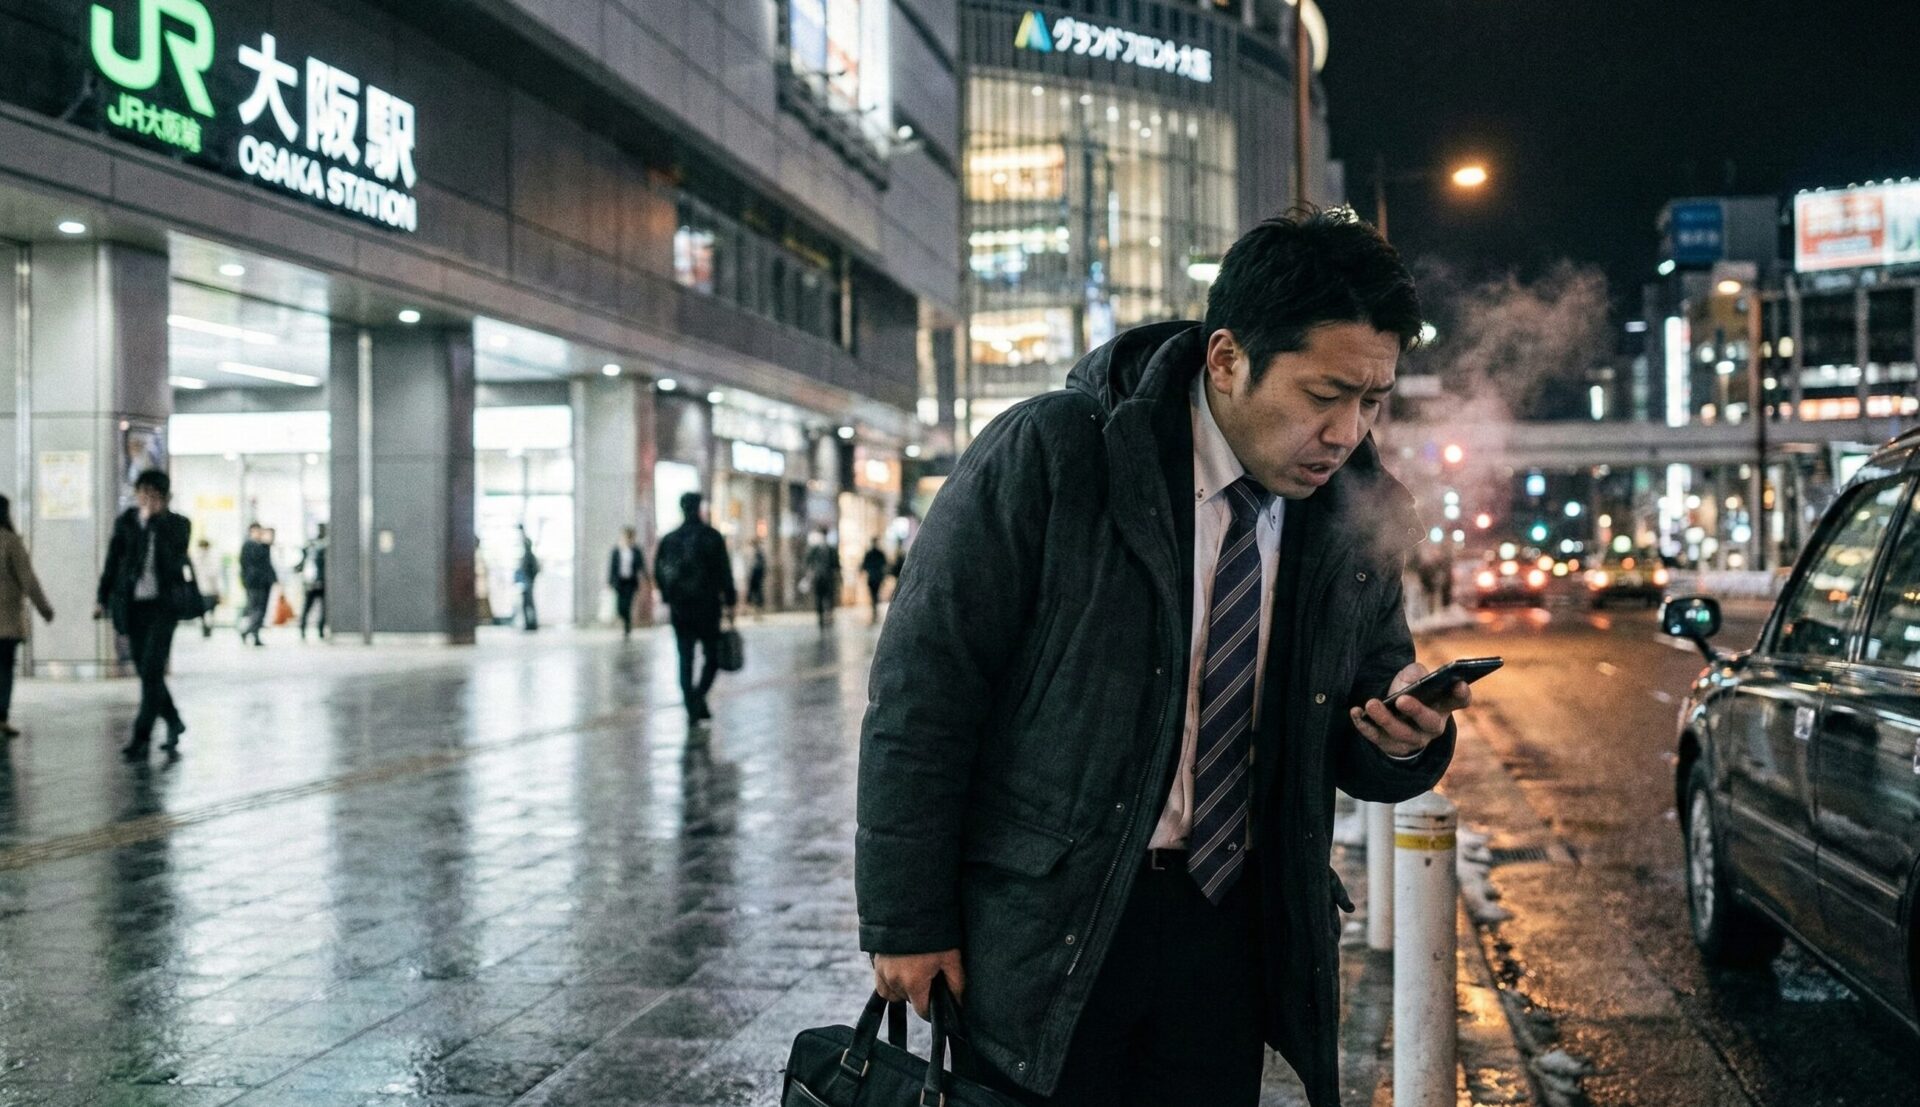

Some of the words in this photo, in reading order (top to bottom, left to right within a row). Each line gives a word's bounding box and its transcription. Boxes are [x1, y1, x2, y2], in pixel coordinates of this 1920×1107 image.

[90, 0, 215, 119] JR
[238, 32, 416, 189] 大阪駅
[238, 135, 325, 199] OSAKA
[327, 166, 417, 232] STATION
